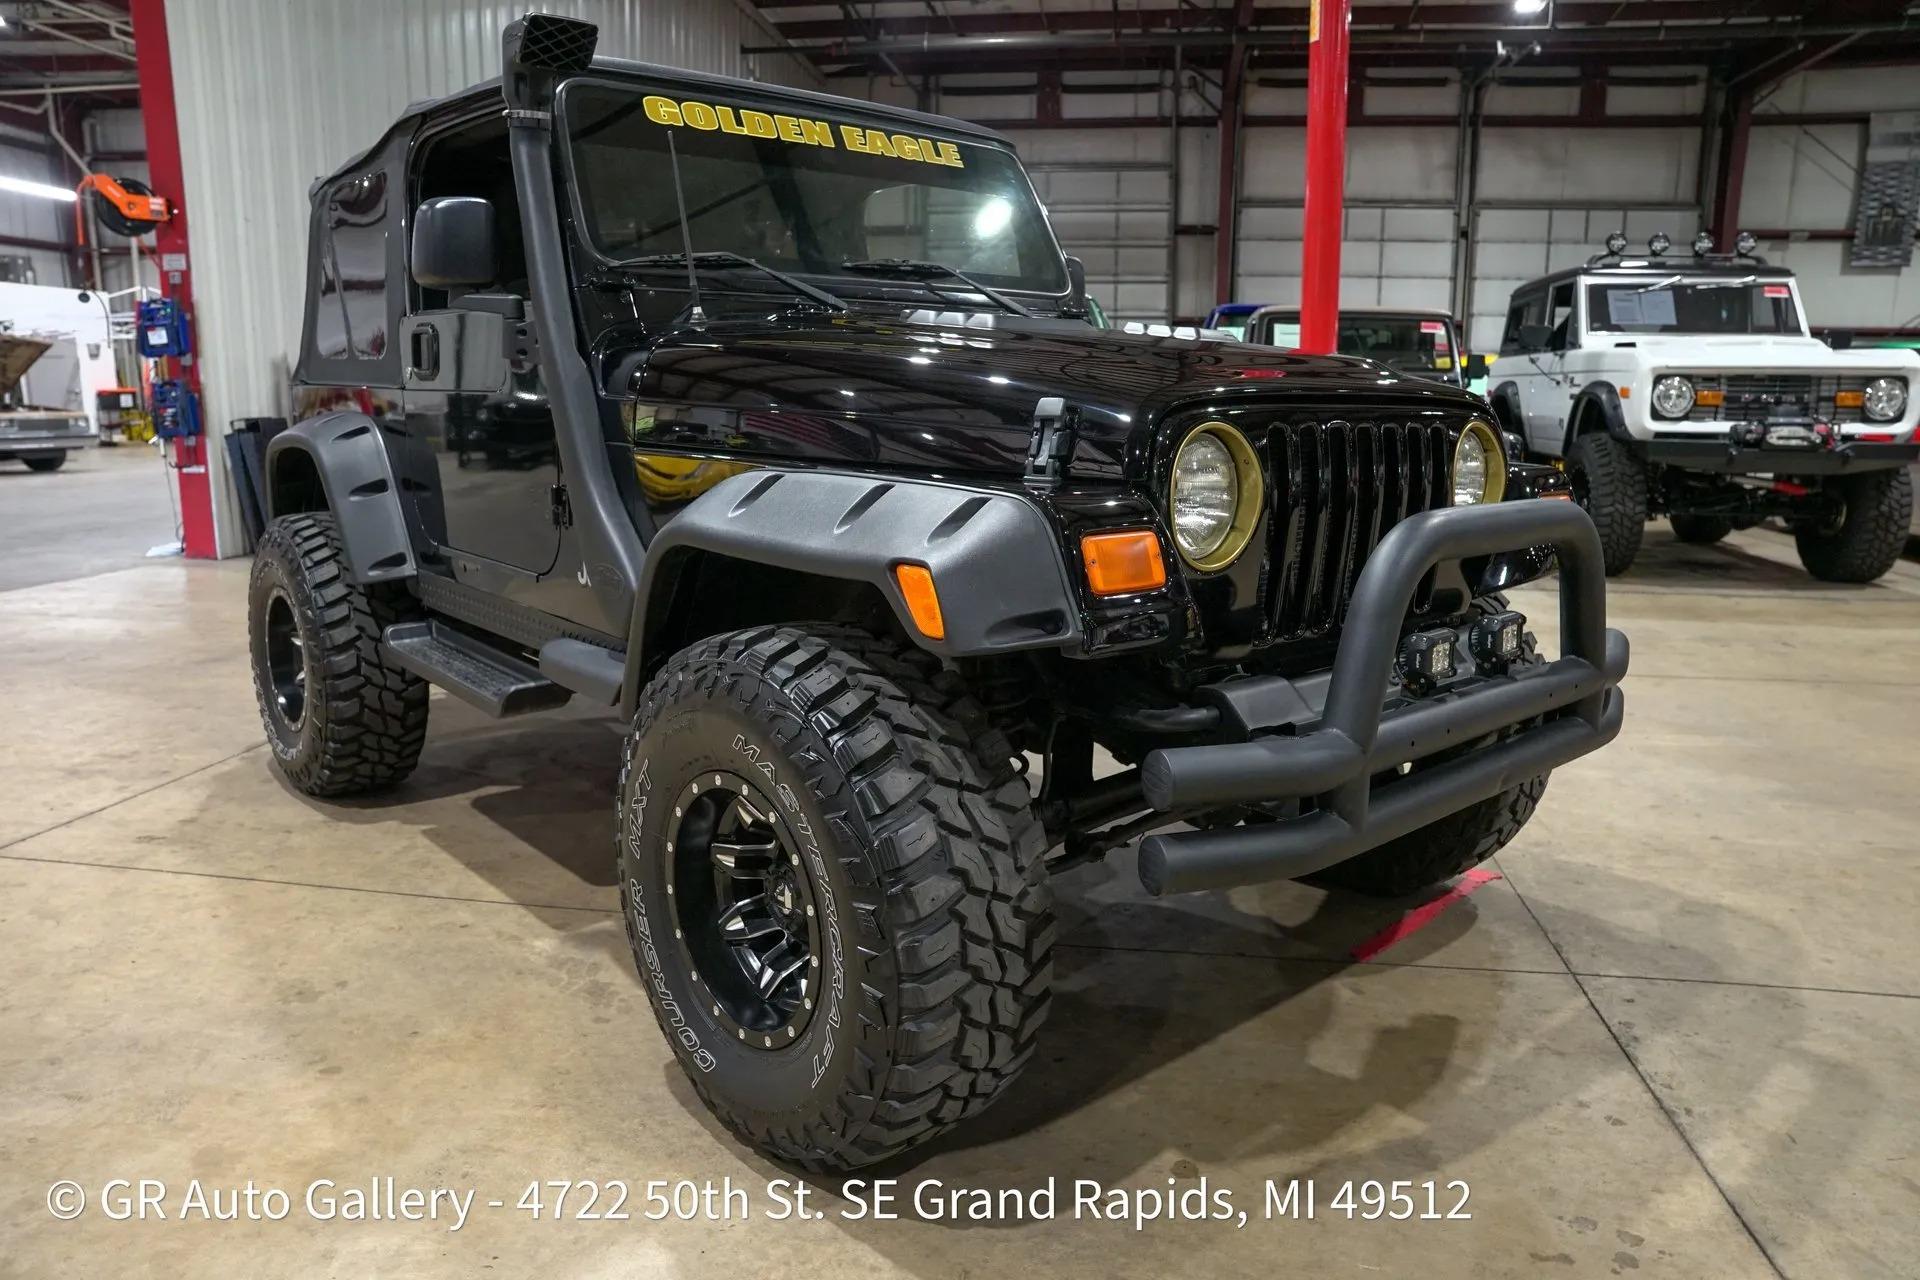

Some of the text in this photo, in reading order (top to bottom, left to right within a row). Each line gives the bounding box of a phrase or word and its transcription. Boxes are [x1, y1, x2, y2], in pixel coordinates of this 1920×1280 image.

[642, 95, 965, 168] GOLDEN EAGLE
[628, 757, 716, 1073] COURSER MXT
[732, 733, 844, 1089] MASTERCRAFT
